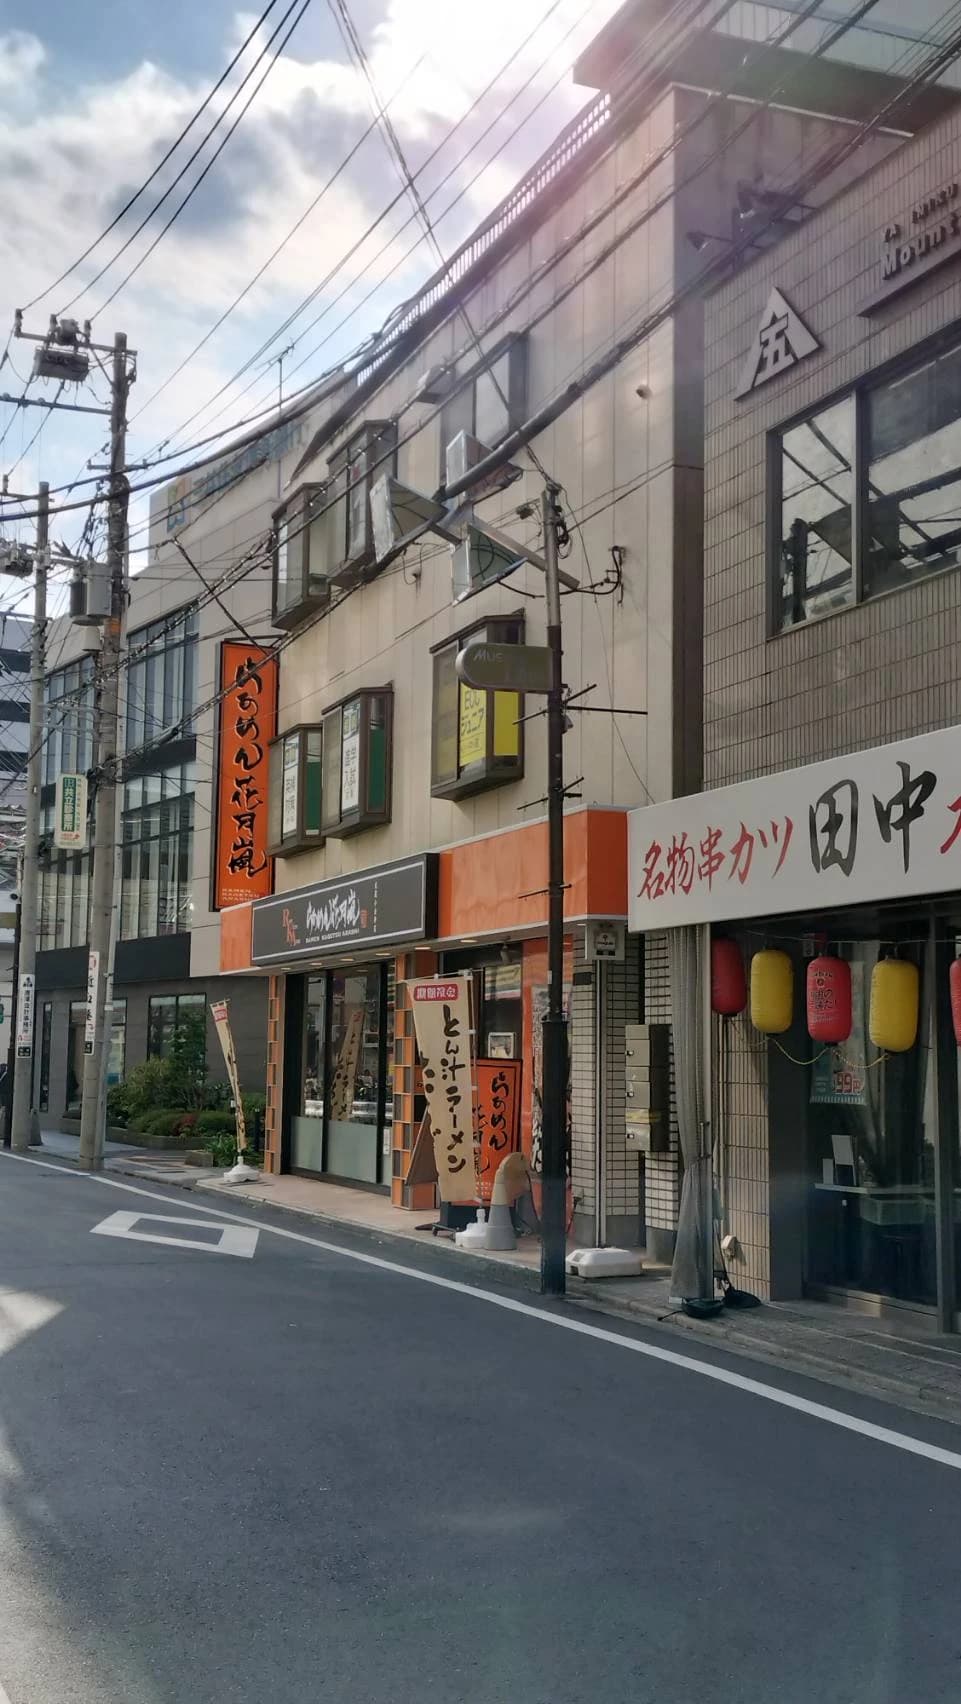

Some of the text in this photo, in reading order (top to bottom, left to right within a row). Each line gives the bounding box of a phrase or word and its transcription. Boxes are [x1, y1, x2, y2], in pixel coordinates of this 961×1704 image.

[637, 815, 794, 901] 名物串カツ
[809, 761, 937, 877] 田中
[440, 1004, 466, 1173] とん汁ラーメン
